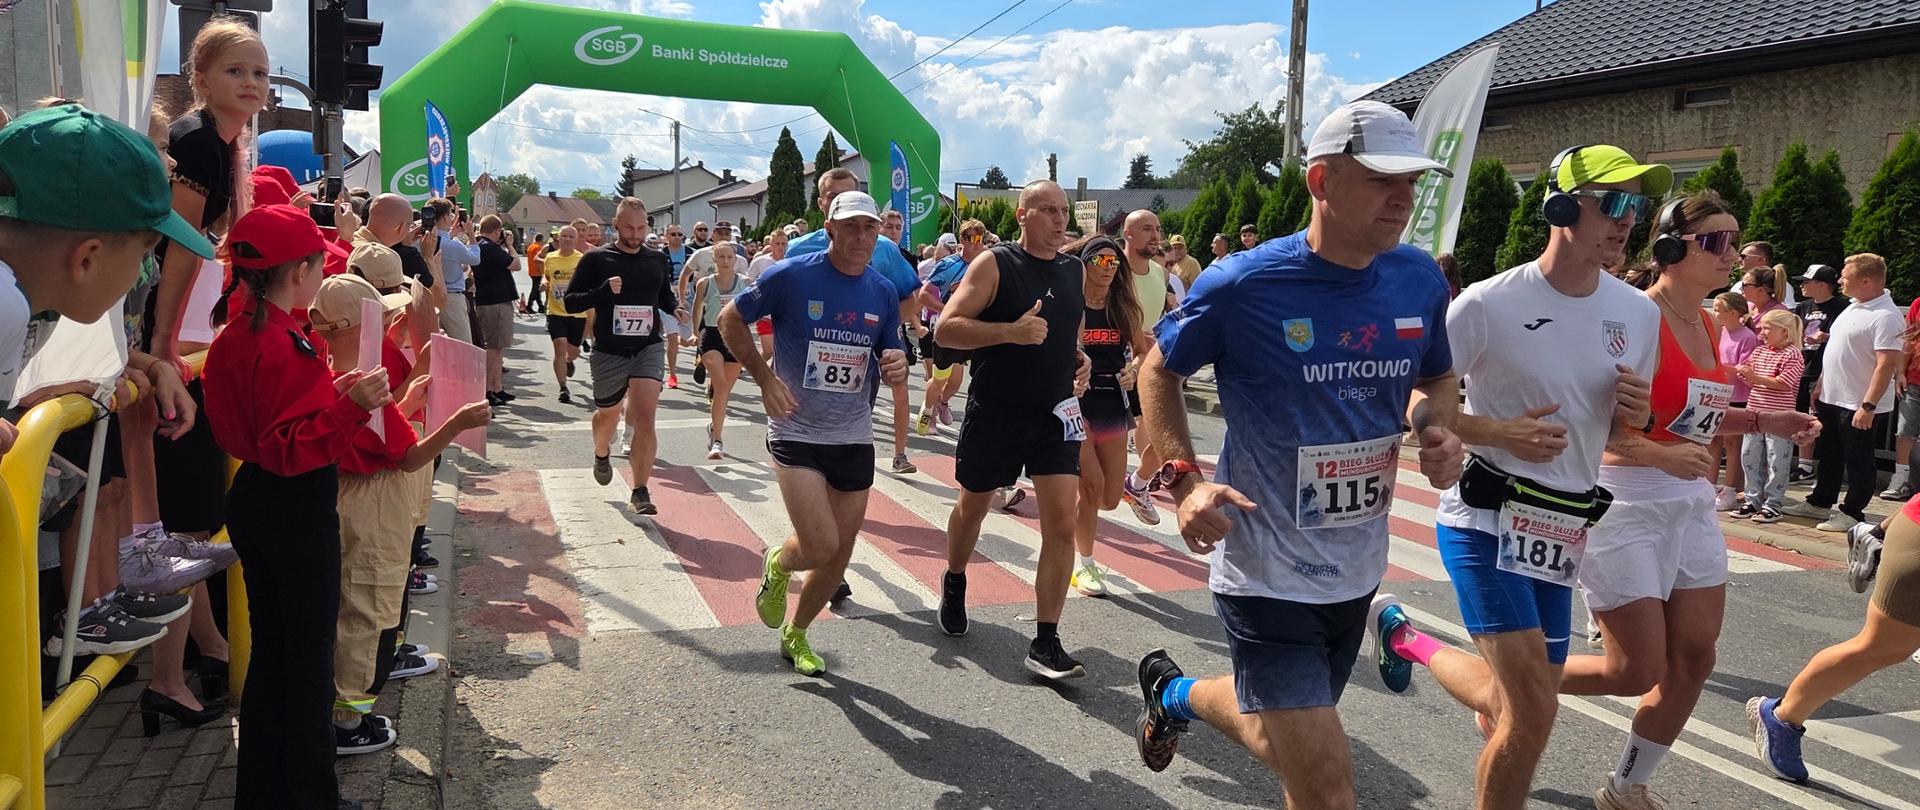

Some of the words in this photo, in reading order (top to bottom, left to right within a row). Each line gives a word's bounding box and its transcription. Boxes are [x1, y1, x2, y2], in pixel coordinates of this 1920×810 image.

[591, 37, 627, 54] SGB
[652, 44, 694, 62] Banki
[698, 47, 789, 70] Spółdzielcze
[404, 173, 429, 187] SG
[910, 201, 925, 213] GB
[619, 310, 628, 318] 12
[626, 319, 644, 331] 77
[813, 327, 871, 345] WITKOWO
[817, 351, 831, 363] 12
[824, 365, 852, 385] 83
[1303, 357, 1412, 383] WITKOWO
[1338, 385, 1377, 401] biega
[1699, 392, 1713, 407] 12
[1315, 460, 1338, 479] 12
[1340, 457, 1363, 468] BIEG
[1325, 476, 1380, 513] 115
[1512, 515, 1531, 534] 12
[1531, 520, 1552, 530] BIEG
[1516, 535, 1564, 572] 181
[1621, 744, 1640, 779] SALOMON
